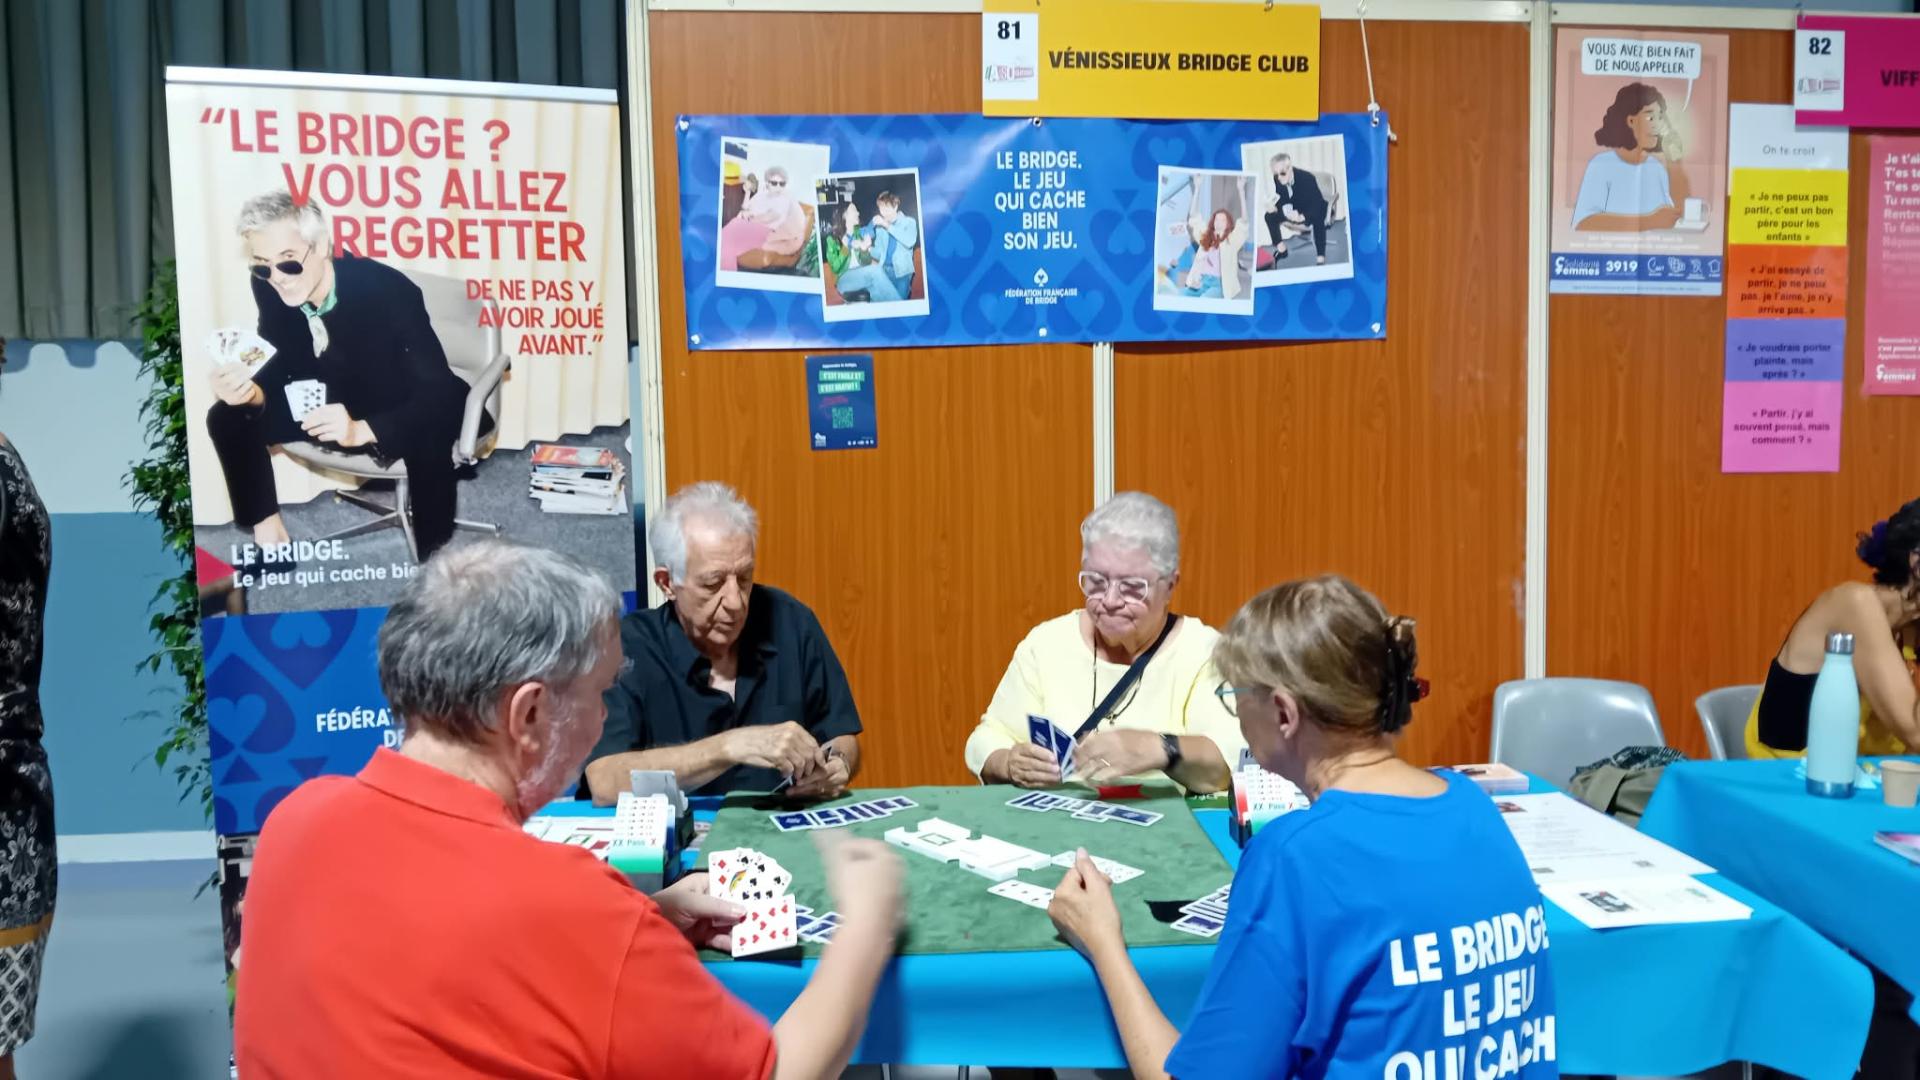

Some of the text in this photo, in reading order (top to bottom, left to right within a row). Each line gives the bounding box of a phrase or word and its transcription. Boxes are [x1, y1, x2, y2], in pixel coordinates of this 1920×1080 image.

[998, 20, 1020, 40] 81
[1588, 43, 1617, 56] VOUS
[1620, 44, 1643, 58] AVEZ
[1808, 37, 1832, 55] 82
[1048, 47, 1310, 73] VÉNISSIEUX BRIDGE CLUB
[1595, 59, 1685, 73] DE NOUS APPELER
[297, 111, 466, 160] BRIDGE
[482, 119, 511, 162] ?
[1762, 144, 1816, 155] On te croit
[996, 150, 1082, 169] LE BRIDGE.
[281, 162, 568, 212] VOUS ALLEZ
[1014, 171, 1066, 190] LE JEU
[994, 190, 1086, 213] QUI CACHE
[1757, 192, 1770, 201] Je
[1772, 194, 1784, 202] ne
[1786, 194, 1811, 204] peux
[1812, 195, 1829, 204] pas
[1022, 211, 1058, 230] BIEN
[1801, 207, 1814, 215] un
[1816, 206, 1834, 216] bon
[1781, 219, 1805, 230] pour
[1806, 218, 1821, 228] les
[332, 215, 586, 262] REGRETTER
[1004, 231, 1078, 250] SON JEU.
[1766, 231, 1802, 241] enfants
[1605, 260, 1639, 272] 3919
[466, 279, 594, 302] DE NE PAS Y
[478, 302, 604, 329] AVOIR JOUÉ
[231, 540, 350, 567] LE BRIDGE.
[232, 570, 254, 588] Le
[258, 569, 290, 590] jeu
[295, 567, 325, 588] qui
[329, 564, 386, 582] cache
[1390, 931, 1443, 987] LE
[1443, 964, 1536, 1038] LE JEU
